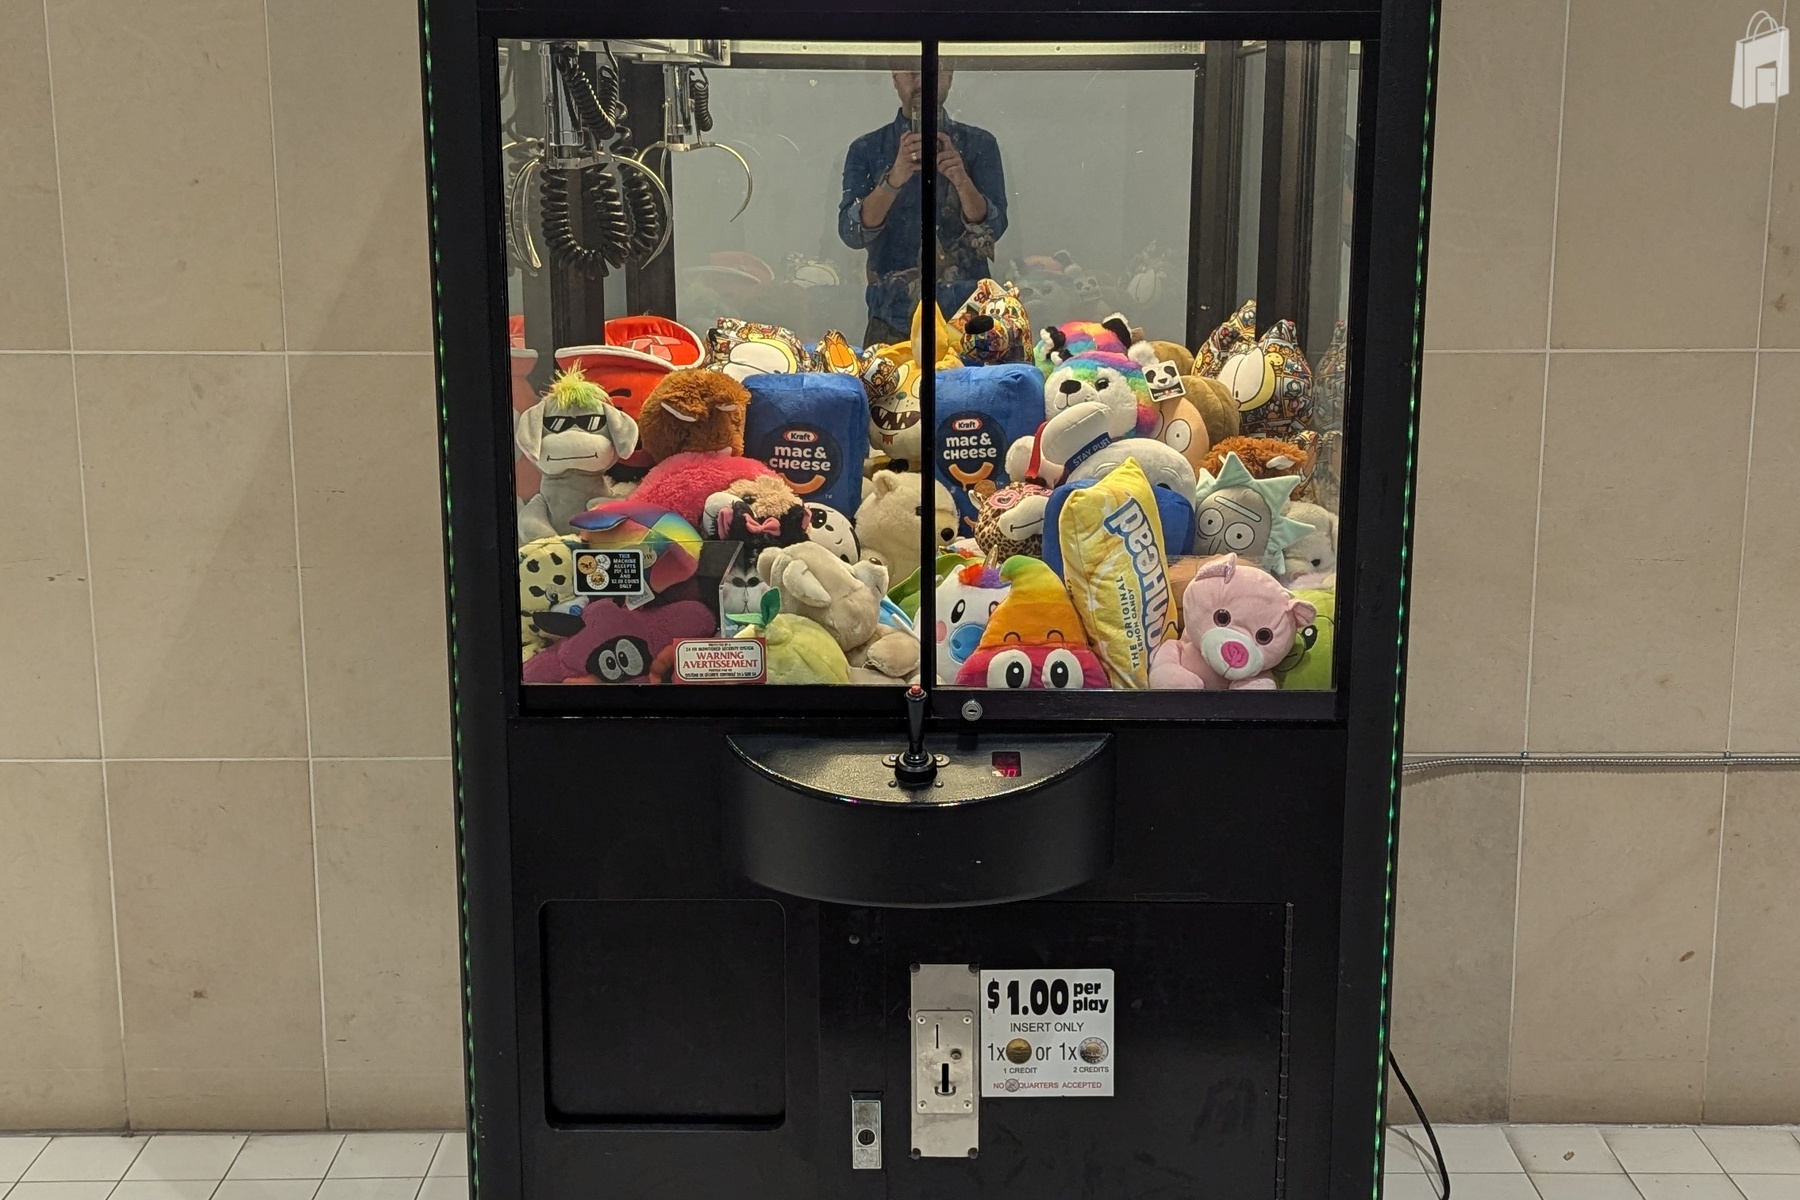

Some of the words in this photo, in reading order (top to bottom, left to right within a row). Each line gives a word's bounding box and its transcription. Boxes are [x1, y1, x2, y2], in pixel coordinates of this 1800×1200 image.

[957, 420, 976, 429] Kraft
[790, 432, 811, 441] Kraft
[945, 435, 978, 448] mac
[979, 432, 992, 446] &
[774, 445, 812, 458] mac
[813, 446, 827, 459] &
[1072, 448, 1092, 467] STAY
[1116, 575, 1134, 639] ORIGINAL
[1128, 588, 1138, 619] CANDY
[1133, 621, 1144, 652] LEMON
[696, 651, 744, 660] WARNING
[1131, 643, 1140, 669] THE
[683, 660, 758, 668] AVERTISSEMENT
[1073, 982, 1102, 997] per
[1072, 997, 1109, 1014] play
[1010, 1022, 1052, 1032] INSERT
[1054, 1022, 1085, 1032] ONLY
[987, 1042, 1006, 1061] 1x
[1035, 1046, 1052, 1061] or
[1059, 1042, 1078, 1061] 1x
[1018, 1081, 1059, 1089] QUARTERS
[1062, 1081, 1102, 1089] ACCEPTED
